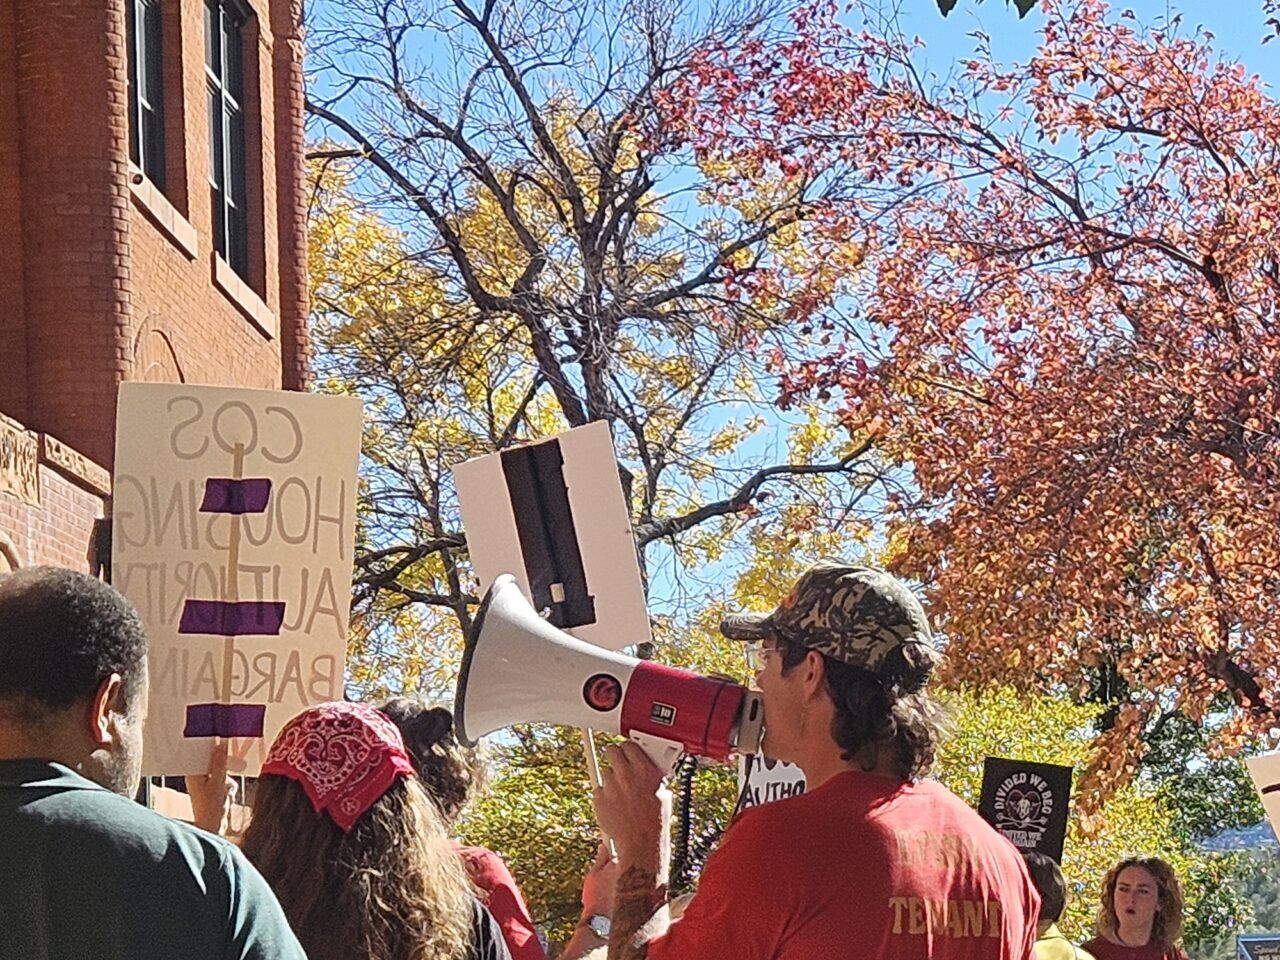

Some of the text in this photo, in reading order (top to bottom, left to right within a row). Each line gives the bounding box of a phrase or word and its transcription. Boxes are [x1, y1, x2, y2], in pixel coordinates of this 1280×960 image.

[741, 780, 806, 810] AUTHO
[994, 773, 1027, 810] DIVIDED
[1030, 773, 1048, 792] WE
